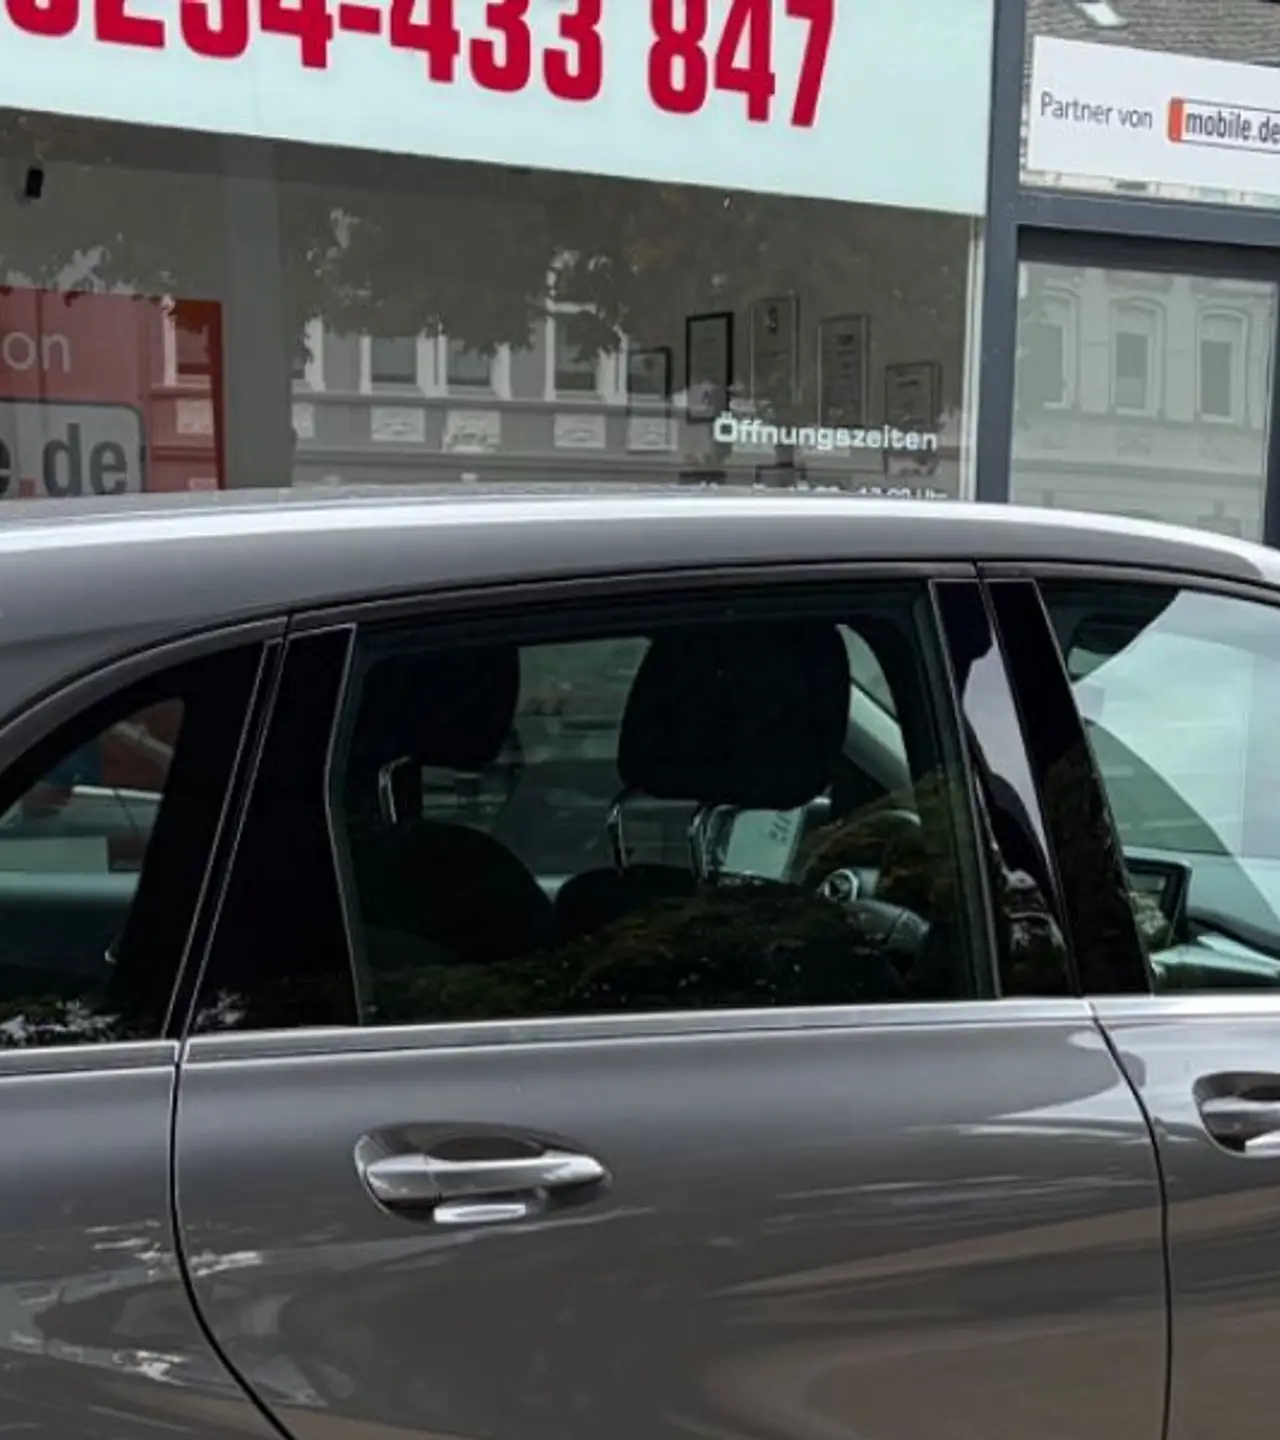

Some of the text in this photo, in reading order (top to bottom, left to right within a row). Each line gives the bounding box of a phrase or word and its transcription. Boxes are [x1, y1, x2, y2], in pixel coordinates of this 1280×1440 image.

[5, 0, 835, 127] 4-433 847
[1040, 90, 1113, 124] Partner
[1117, 108, 1153, 129] von
[713, 410, 938, 451] Öffnungszeiten
